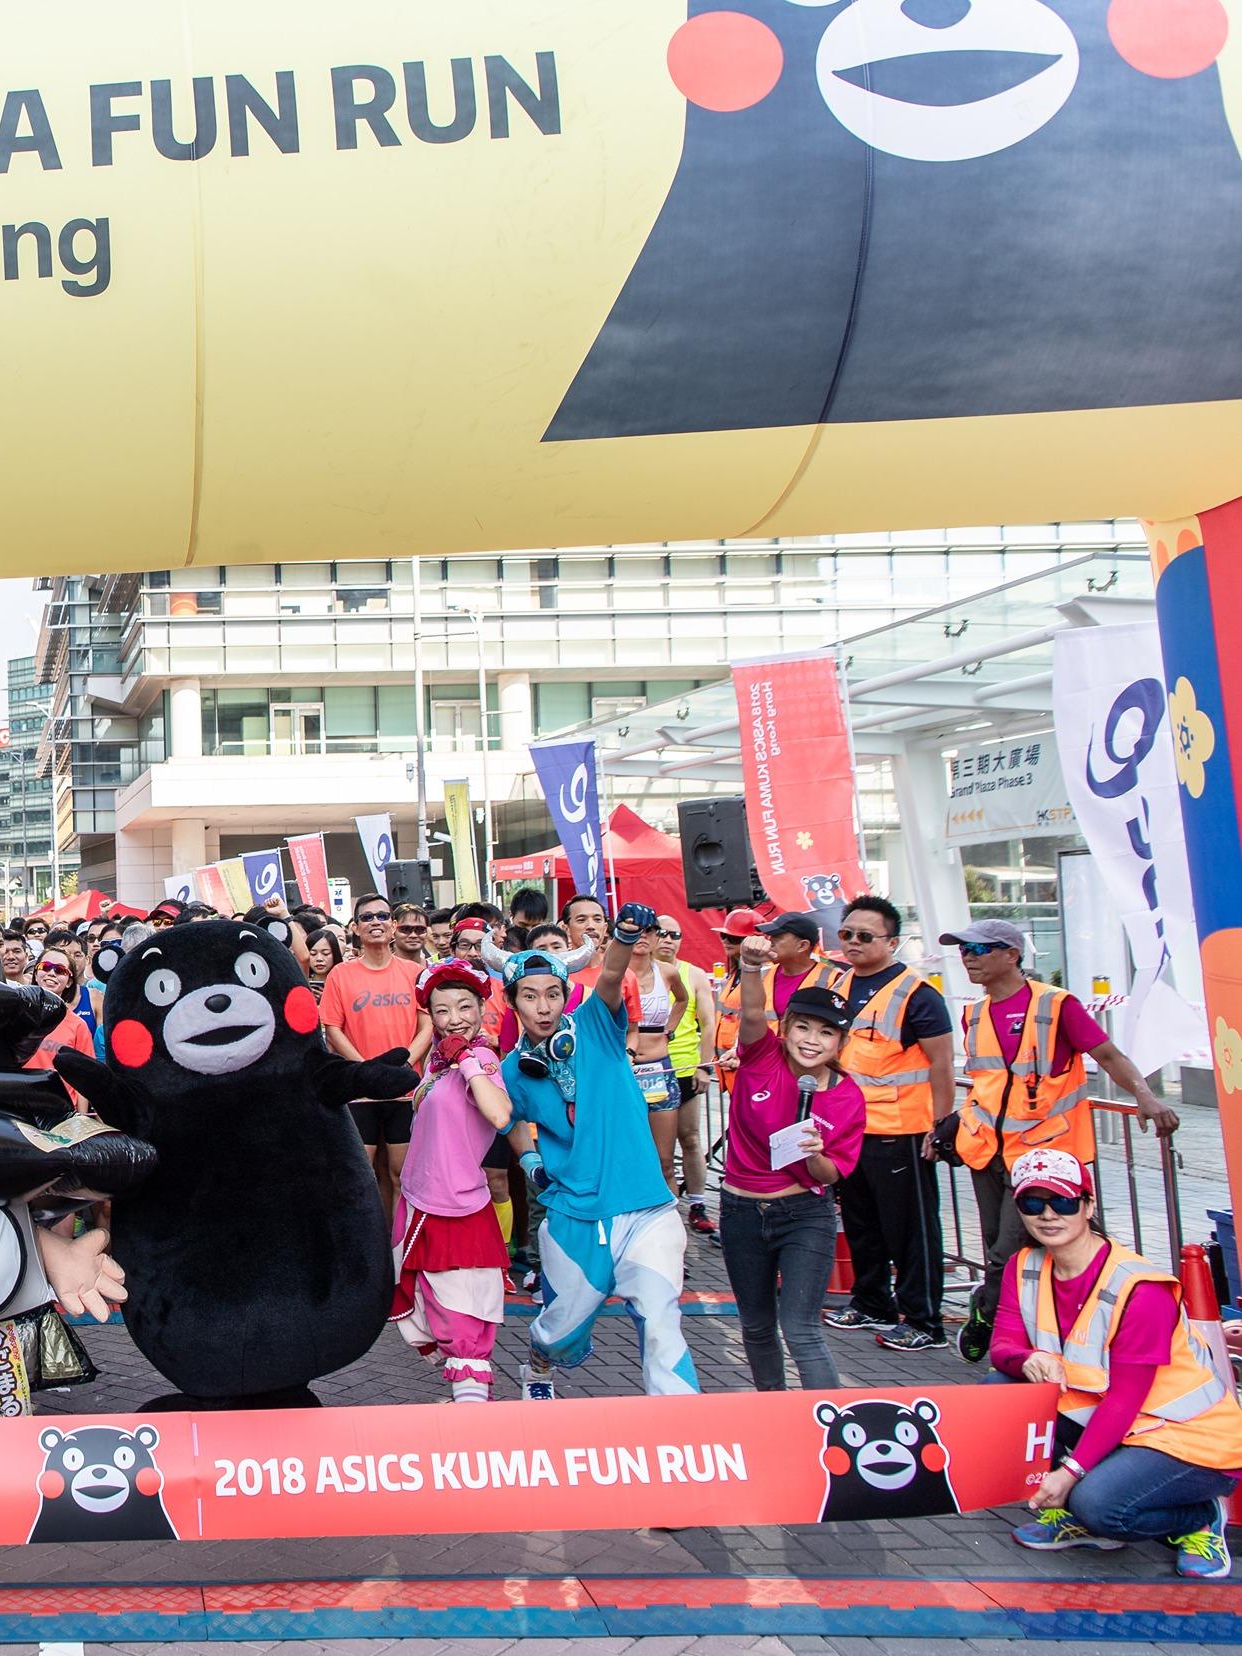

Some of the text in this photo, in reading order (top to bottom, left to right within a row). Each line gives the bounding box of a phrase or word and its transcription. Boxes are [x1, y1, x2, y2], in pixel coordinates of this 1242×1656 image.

[89, 69, 300, 167] FUN
[330, 50, 562, 151] RUN
[975, 780, 997, 794] Plaza
[372, 993, 411, 1006] asics
[213, 1443, 749, 1497] 2018 ASICS KUMA FUN RUN
